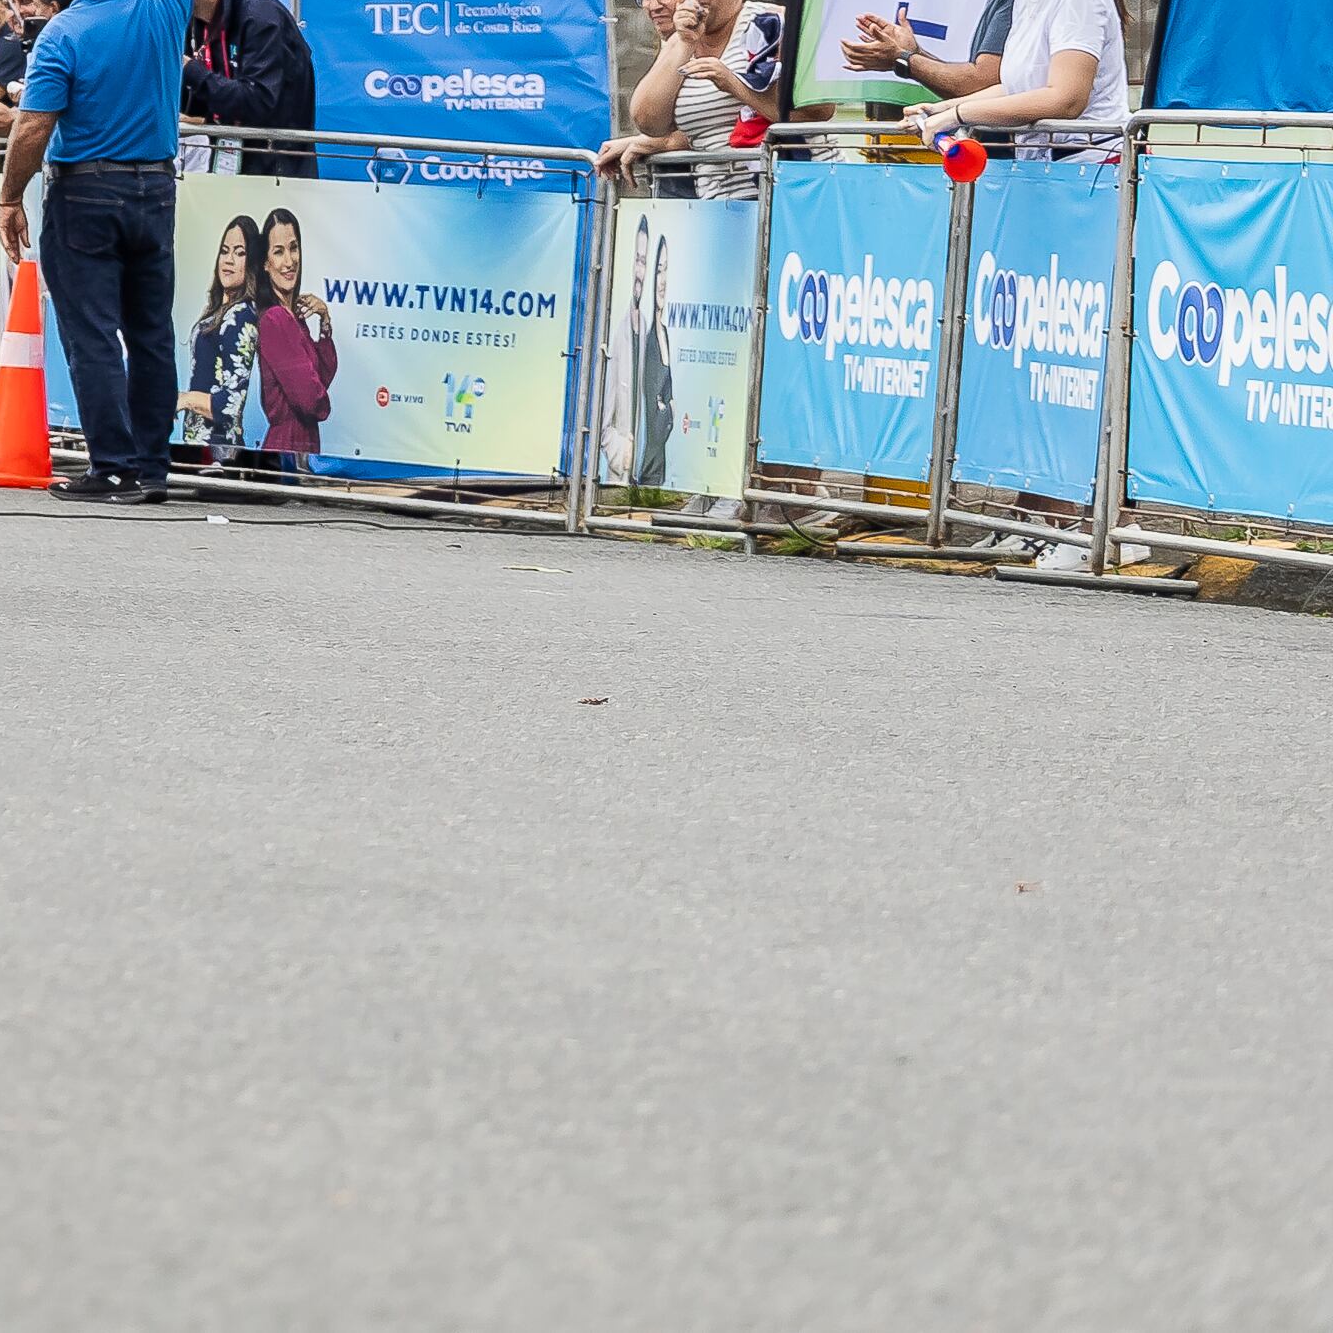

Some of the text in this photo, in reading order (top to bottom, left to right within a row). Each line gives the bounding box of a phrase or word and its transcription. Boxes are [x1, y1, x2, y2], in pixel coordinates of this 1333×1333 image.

[364, 2, 439, 35] TEC
[454, 2, 542, 19] Tecnológico
[454, 21, 542, 33] de Costa Rica
[364, 68, 546, 103] Coopelesca
[324, 278, 557, 318] WWW.TVN14.COM
[778, 251, 934, 360] Coopelesca
[973, 250, 1106, 369] Coopelesca
[410, 328, 460, 345] DONDE
[444, 422, 472, 433] TVN
